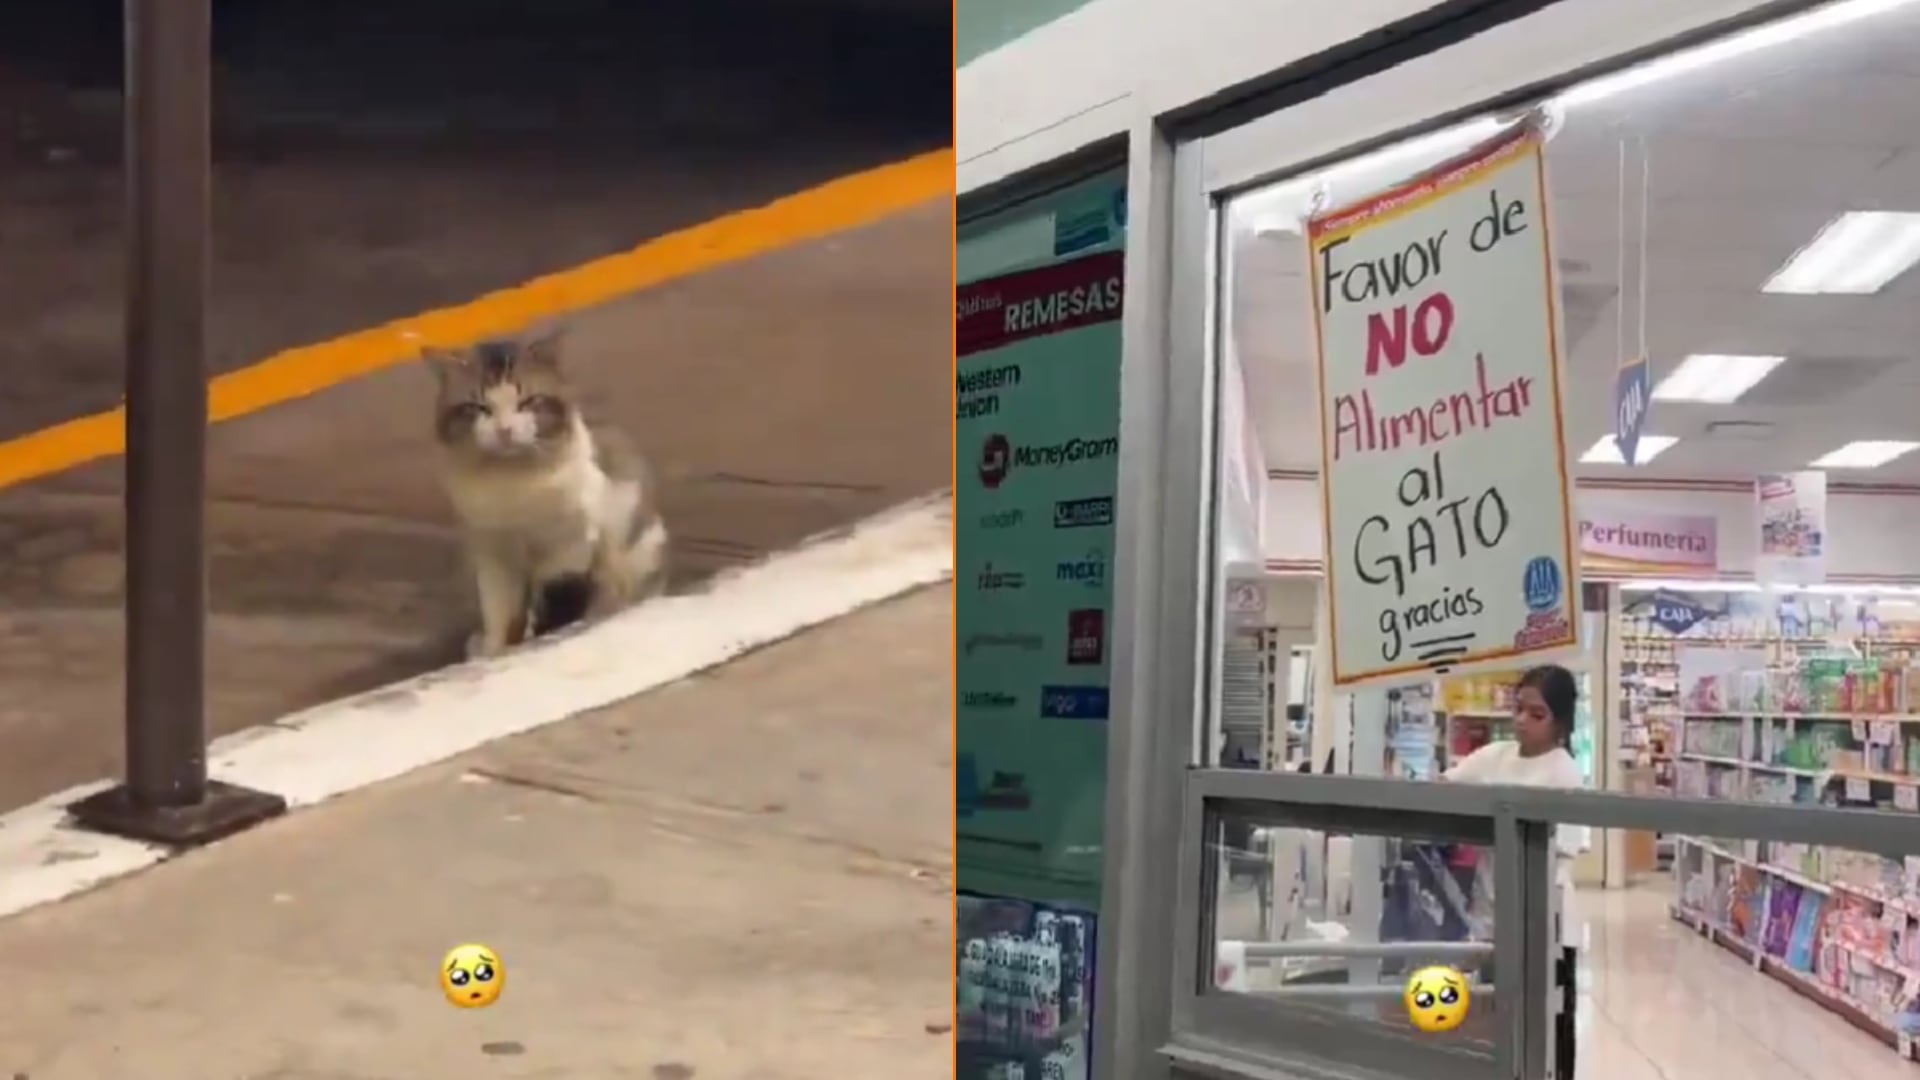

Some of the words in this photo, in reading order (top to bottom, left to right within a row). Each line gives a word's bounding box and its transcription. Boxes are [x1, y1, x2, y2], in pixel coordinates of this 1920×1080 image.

[1320, 230, 1447, 314] Favor
[1470, 190, 1528, 251] de
[1004, 277, 1120, 333] REMESAS
[1365, 292, 1454, 376] NO
[1334, 352, 1533, 461] Alimentar
[1014, 437, 1118, 468] MoneyGram
[1398, 451, 1443, 507] al
[1354, 487, 1509, 597] GATO
[1379, 587, 1484, 662] gracias
[1660, 607, 1694, 623] CAJA
